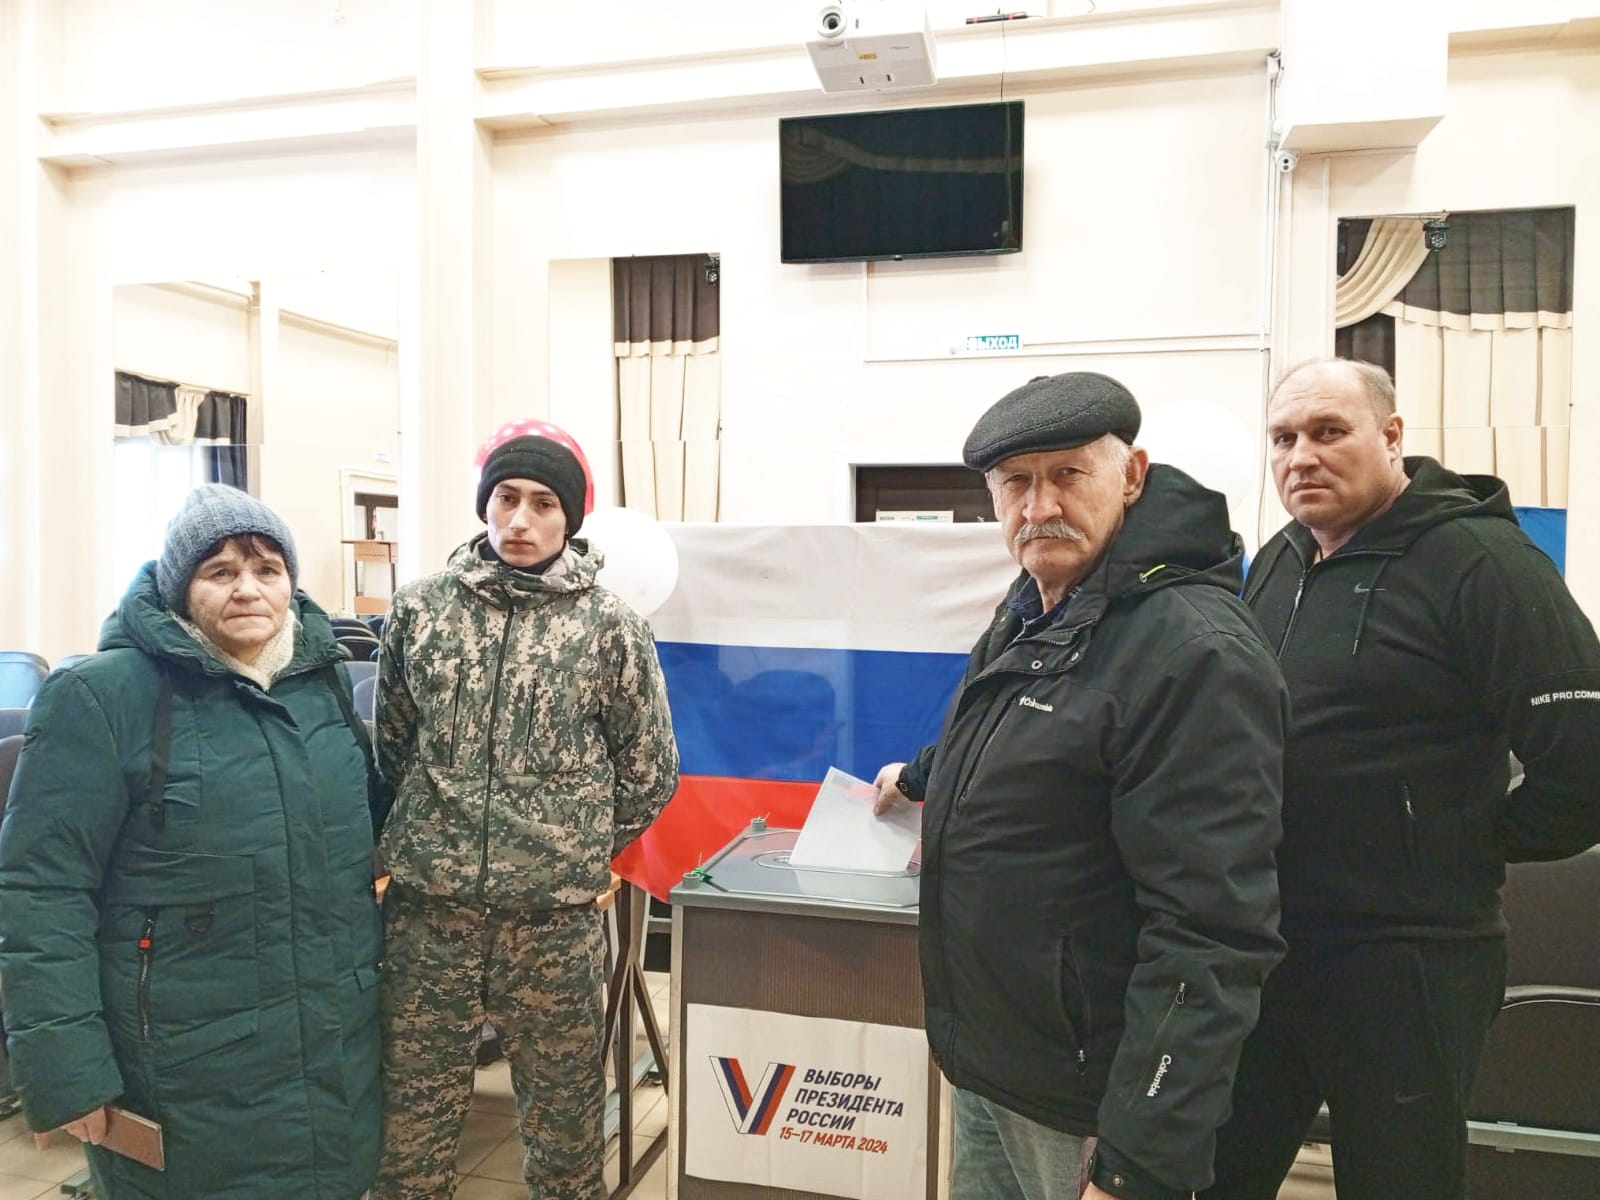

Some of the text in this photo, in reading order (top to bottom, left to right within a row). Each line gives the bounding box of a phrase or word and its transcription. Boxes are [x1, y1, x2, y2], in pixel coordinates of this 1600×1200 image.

[1531, 694, 1551, 706] NIKE
[1552, 692, 1573, 701] PRO
[803, 1068, 881, 1092] ВЫБОРЫ
[795, 1088, 904, 1117] ПРЕЗИДЕНТА
[786, 1108, 856, 1131] РОССИИ
[813, 1131, 856, 1150] МАРТА
[857, 1136, 888, 1154] 2024
